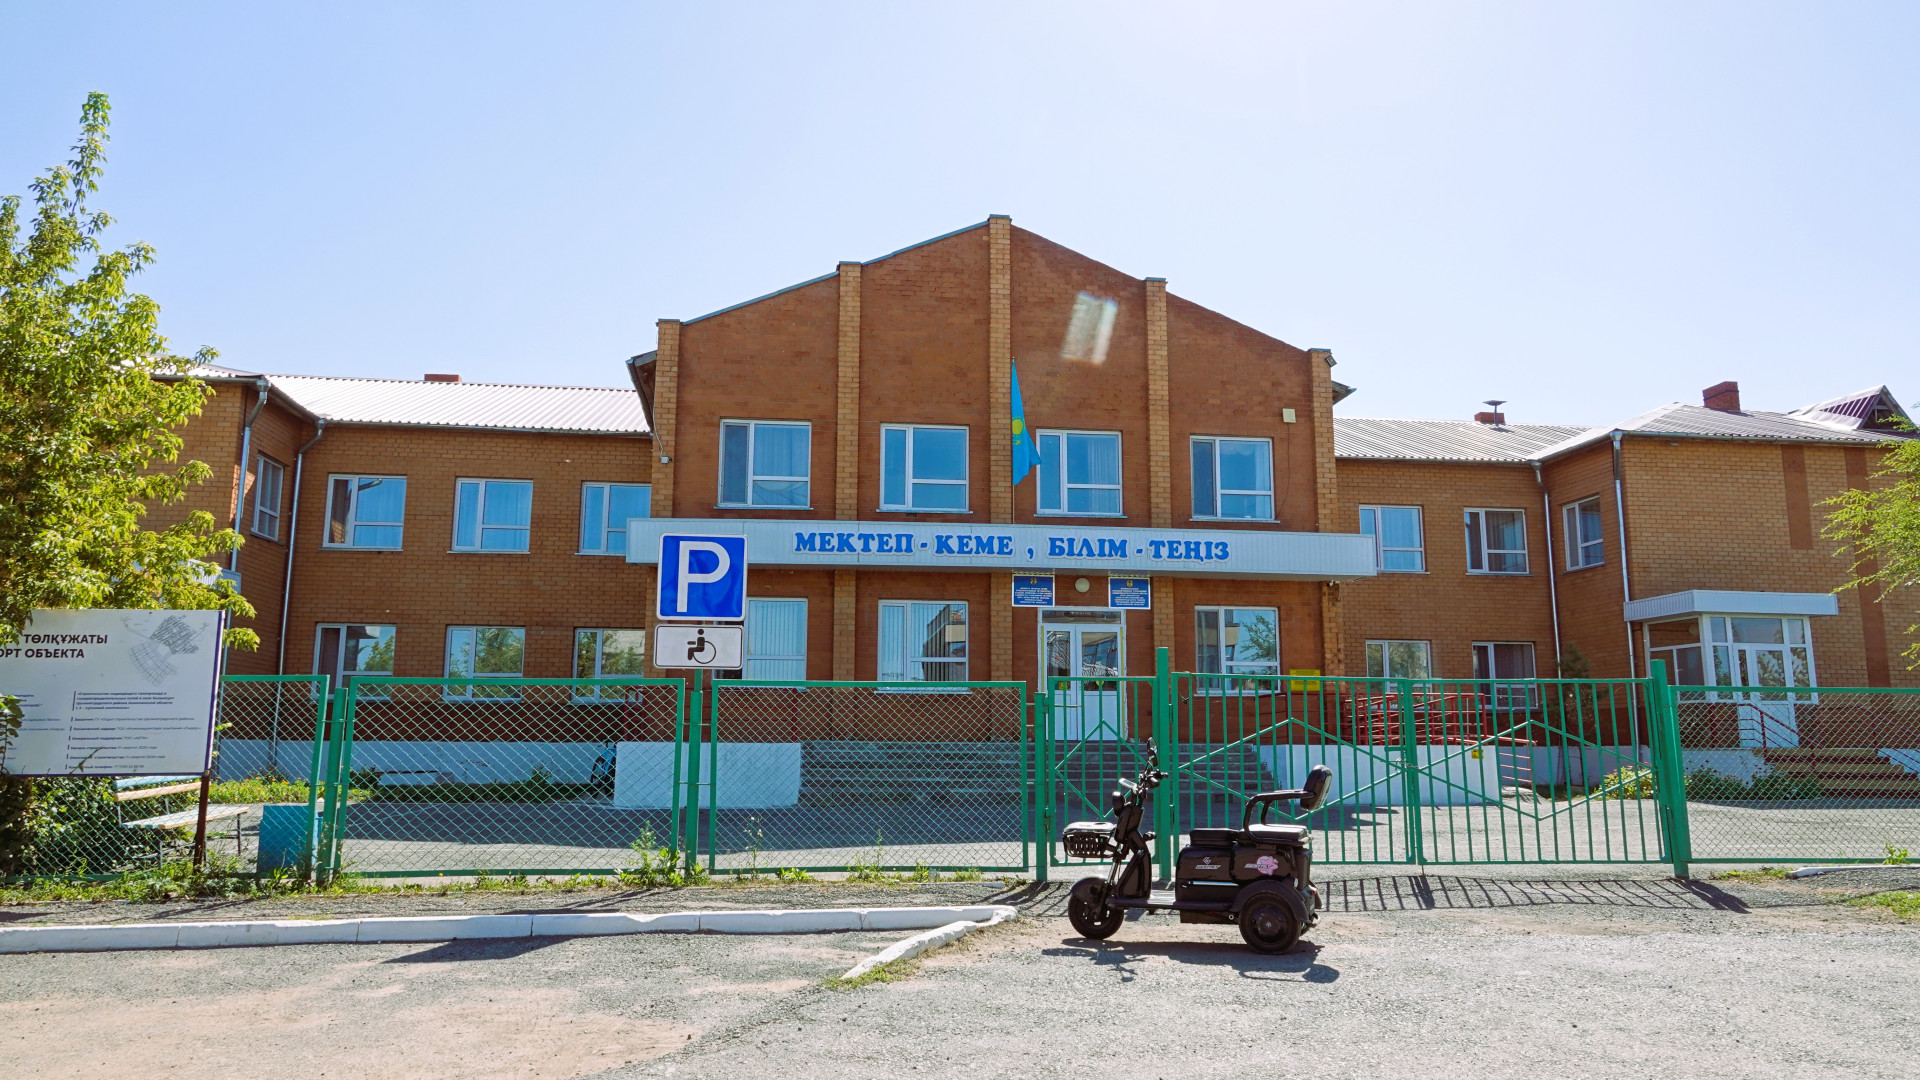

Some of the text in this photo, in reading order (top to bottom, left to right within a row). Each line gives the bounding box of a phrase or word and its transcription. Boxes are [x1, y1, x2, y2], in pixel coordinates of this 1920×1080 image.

[795, 532, 913, 553] МЕКТЕП
[677, 541, 730, 612] P
[24, 634, 108, 645] ТӨЛҚҰЖАТЫ
[25, 649, 84, 658] ОБЪЕКТА
